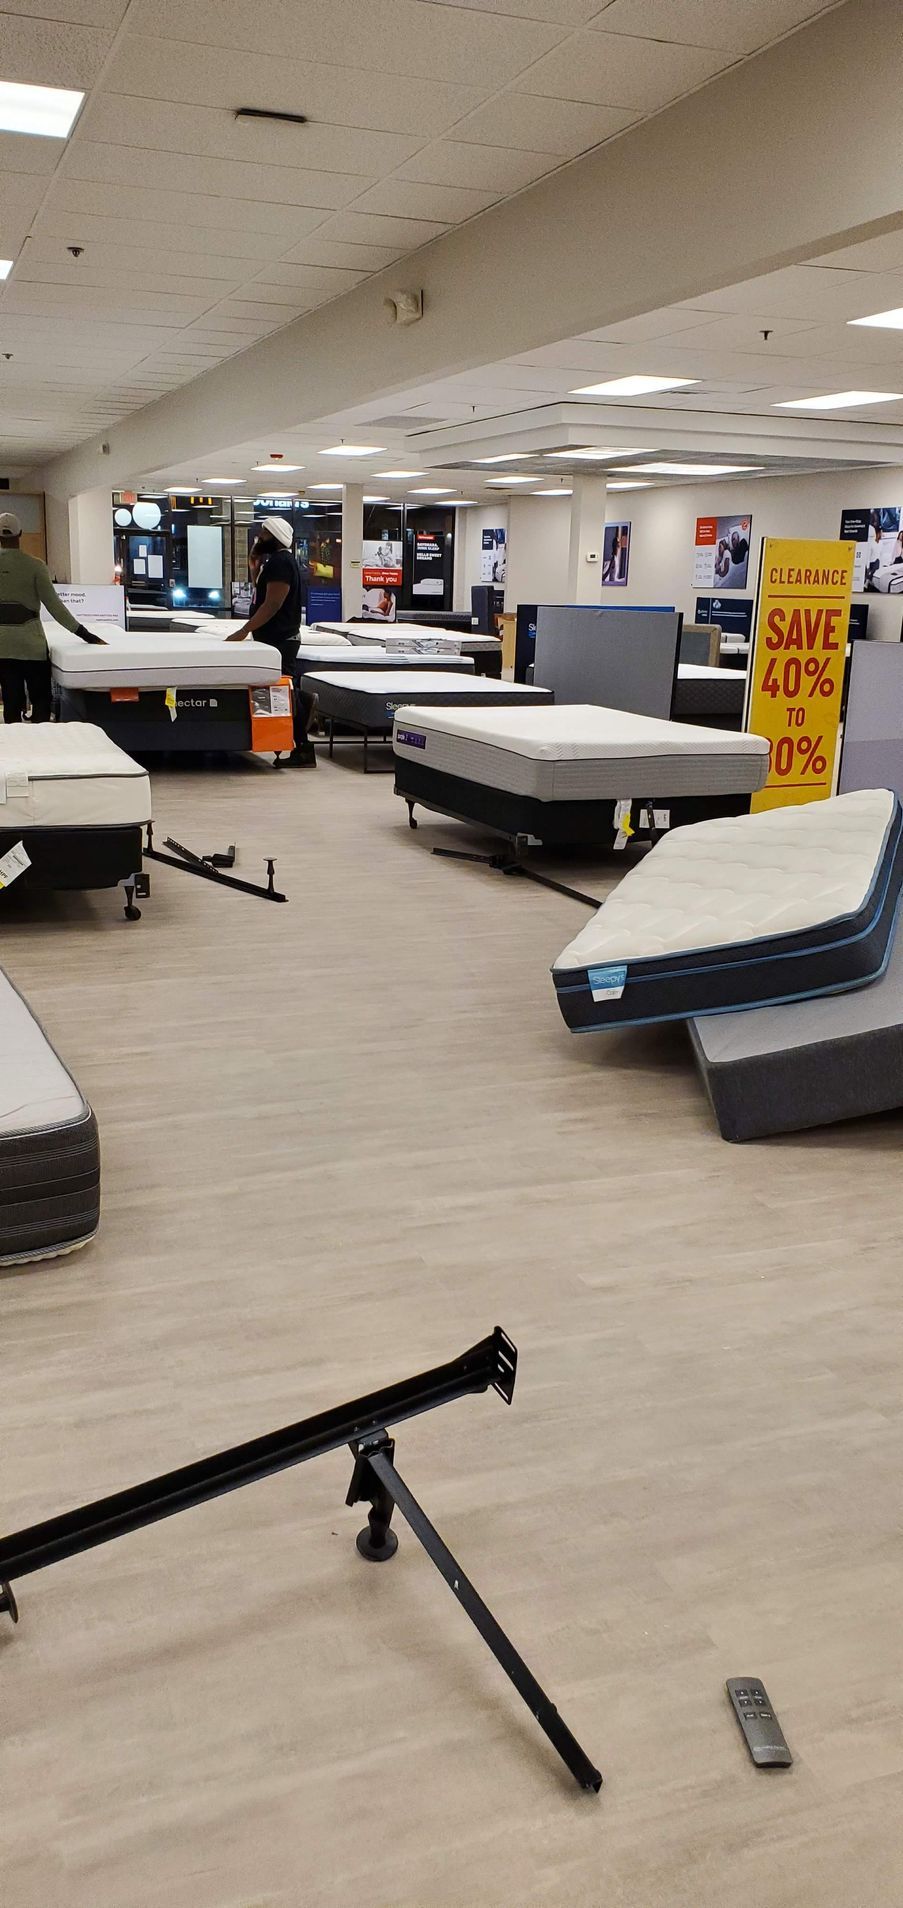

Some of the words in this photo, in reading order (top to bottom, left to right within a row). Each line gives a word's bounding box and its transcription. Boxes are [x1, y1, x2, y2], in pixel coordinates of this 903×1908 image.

[365, 575, 385, 583] Thank
[385, 576, 398, 584] you
[769, 567, 848, 587] CLEARANCE
[765, 607, 842, 651] SAVE
[761, 656, 835, 699] 40%
[786, 706, 806, 728] TO
